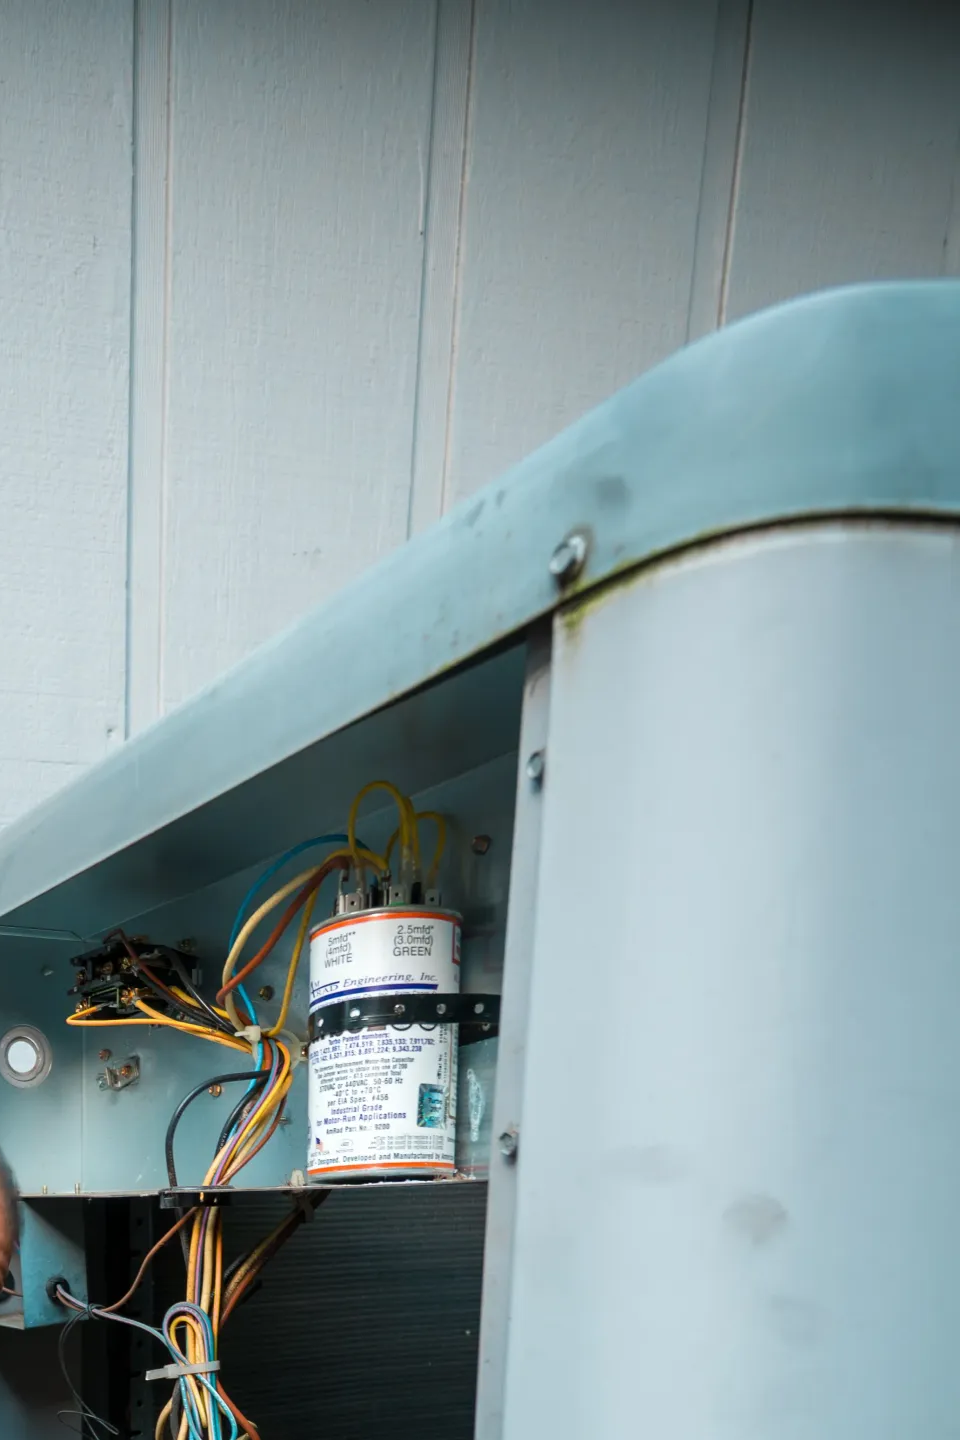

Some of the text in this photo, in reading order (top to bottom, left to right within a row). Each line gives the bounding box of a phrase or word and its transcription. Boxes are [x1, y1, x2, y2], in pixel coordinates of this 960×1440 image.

[394, 935, 433, 946] (3.0mfd)
[326, 943, 351, 958] (4mfd)
[393, 947, 432, 957] GREEN
[324, 953, 352, 968] WHITE
[420, 972, 438, 981] Inc.
[359, 1111, 407, 1122] Applications
